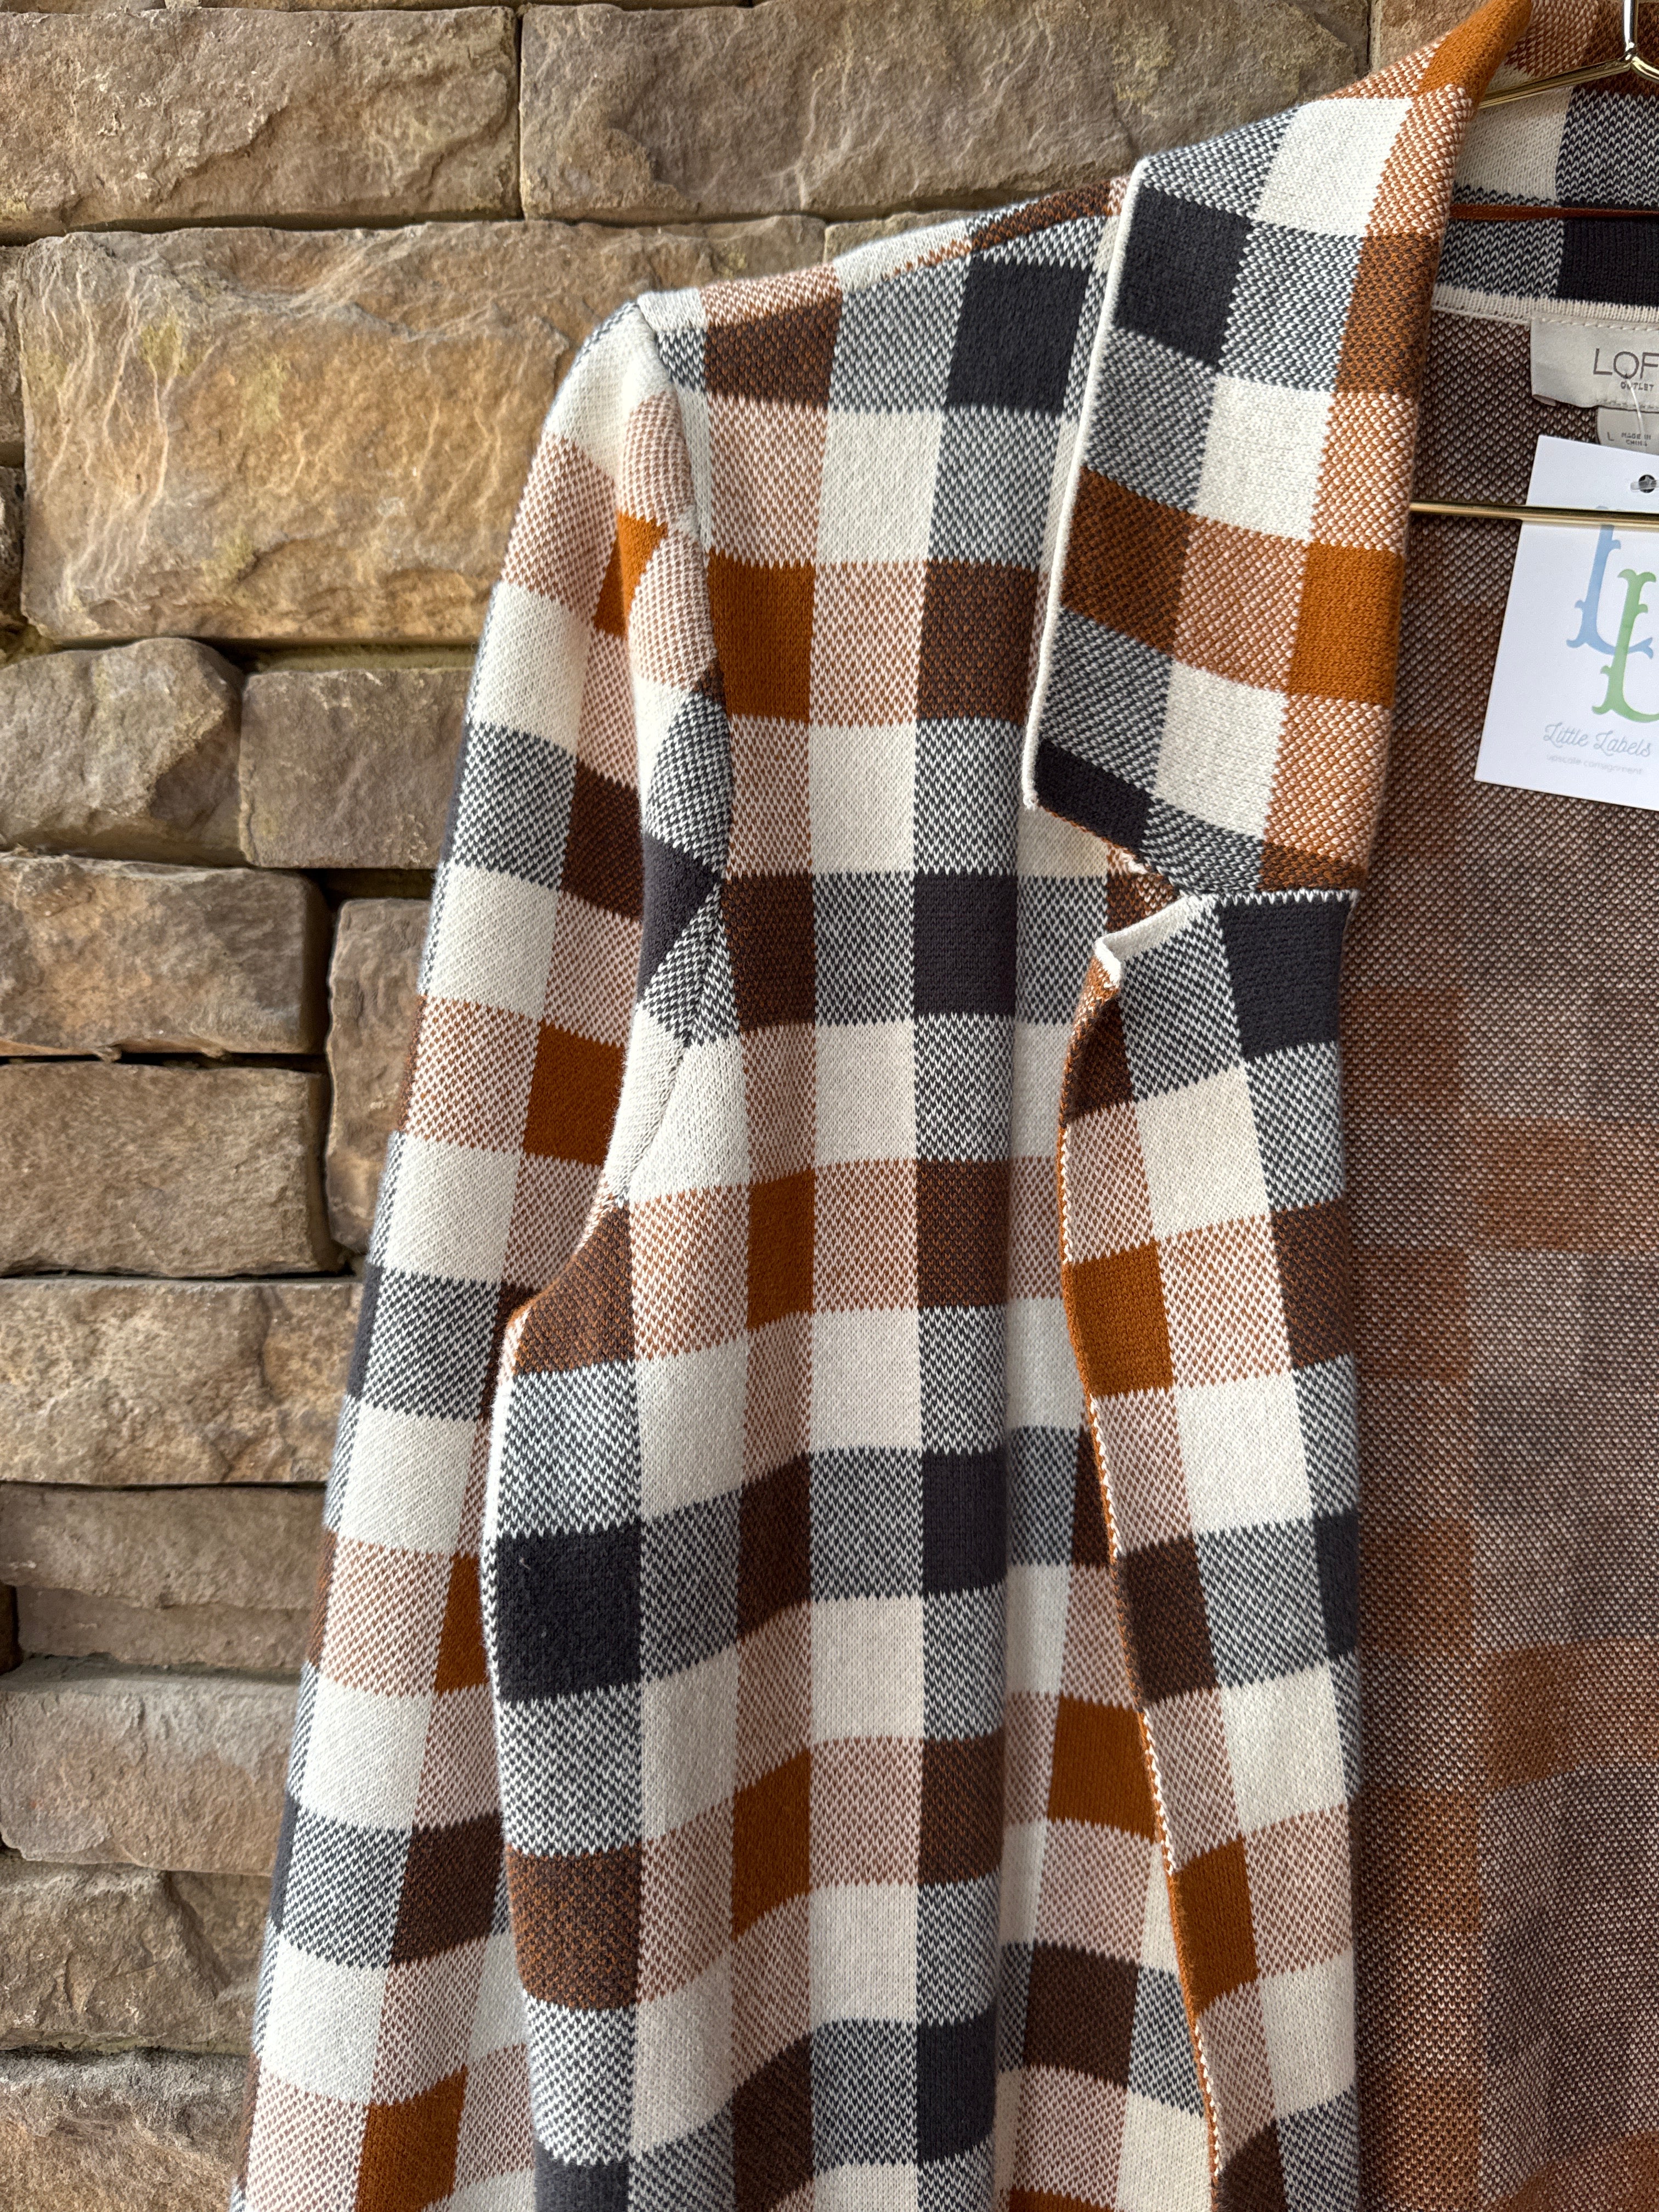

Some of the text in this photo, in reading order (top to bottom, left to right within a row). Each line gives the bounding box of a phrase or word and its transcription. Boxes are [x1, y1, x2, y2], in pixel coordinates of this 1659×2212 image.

[1607, 432, 1615, 441] L
[1543, 722, 1651, 757] Little Labels
